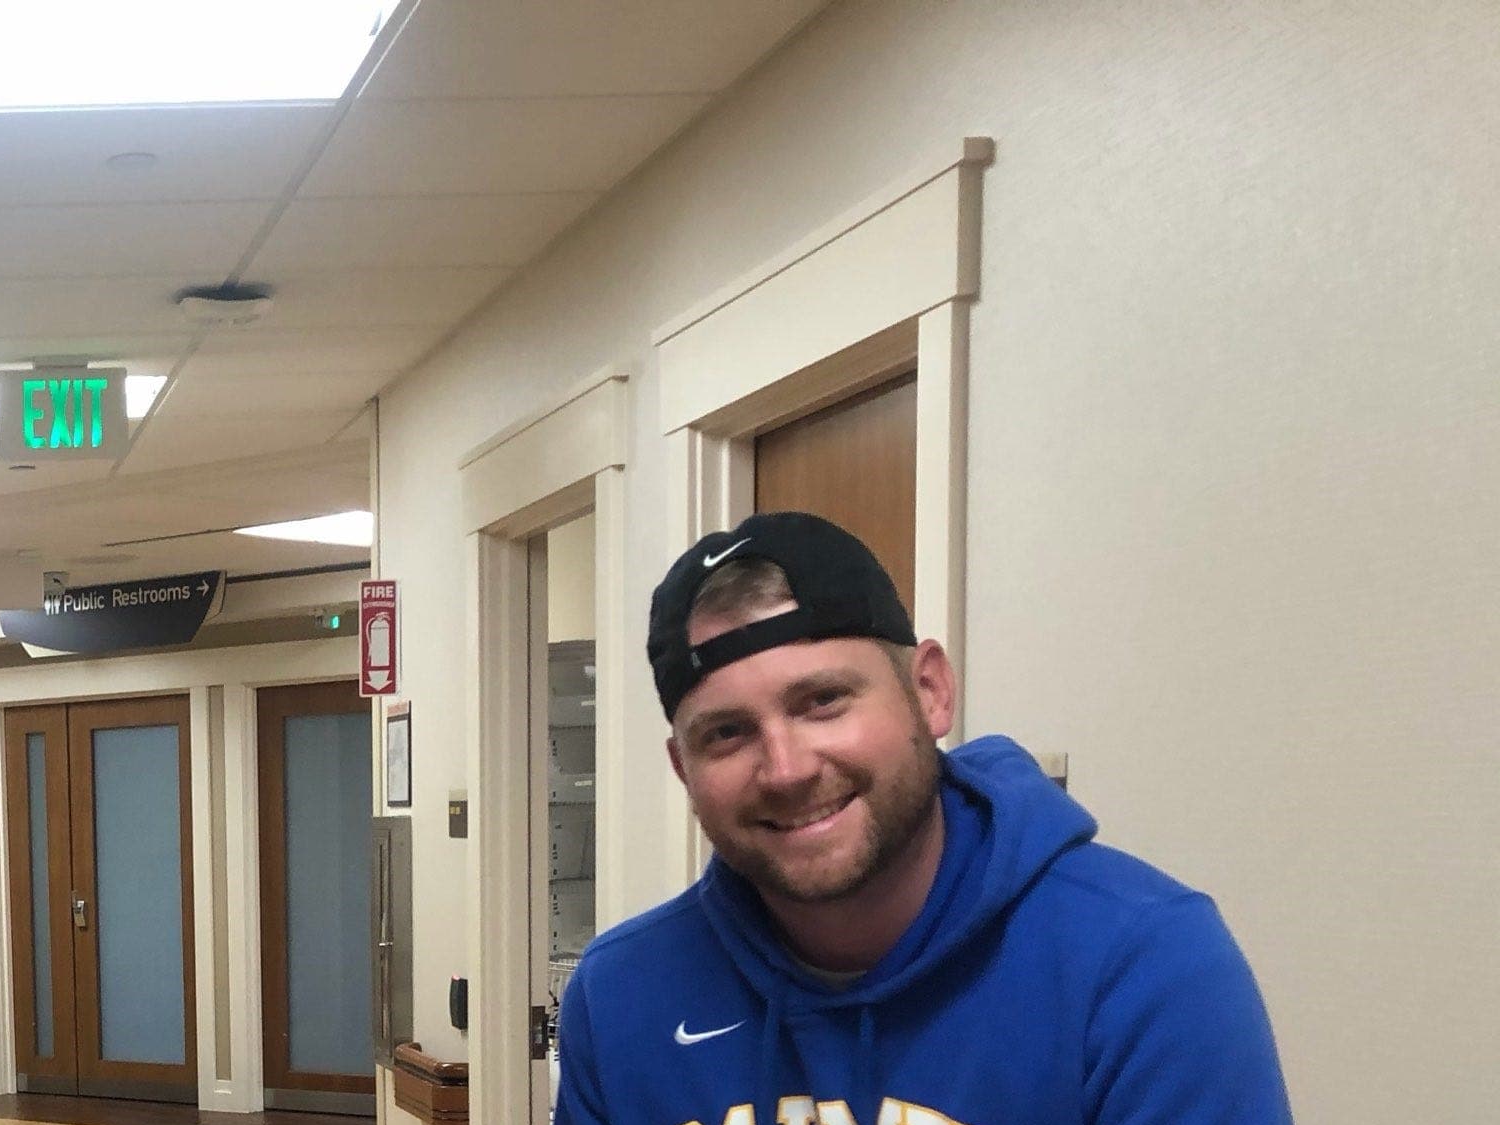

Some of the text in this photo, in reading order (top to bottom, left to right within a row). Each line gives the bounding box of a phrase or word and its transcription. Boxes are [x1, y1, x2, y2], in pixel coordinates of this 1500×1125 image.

[22, 378, 108, 449] EXIT
[63, 585, 191, 613] Public Restrooms
[363, 585, 394, 599] FIRE
